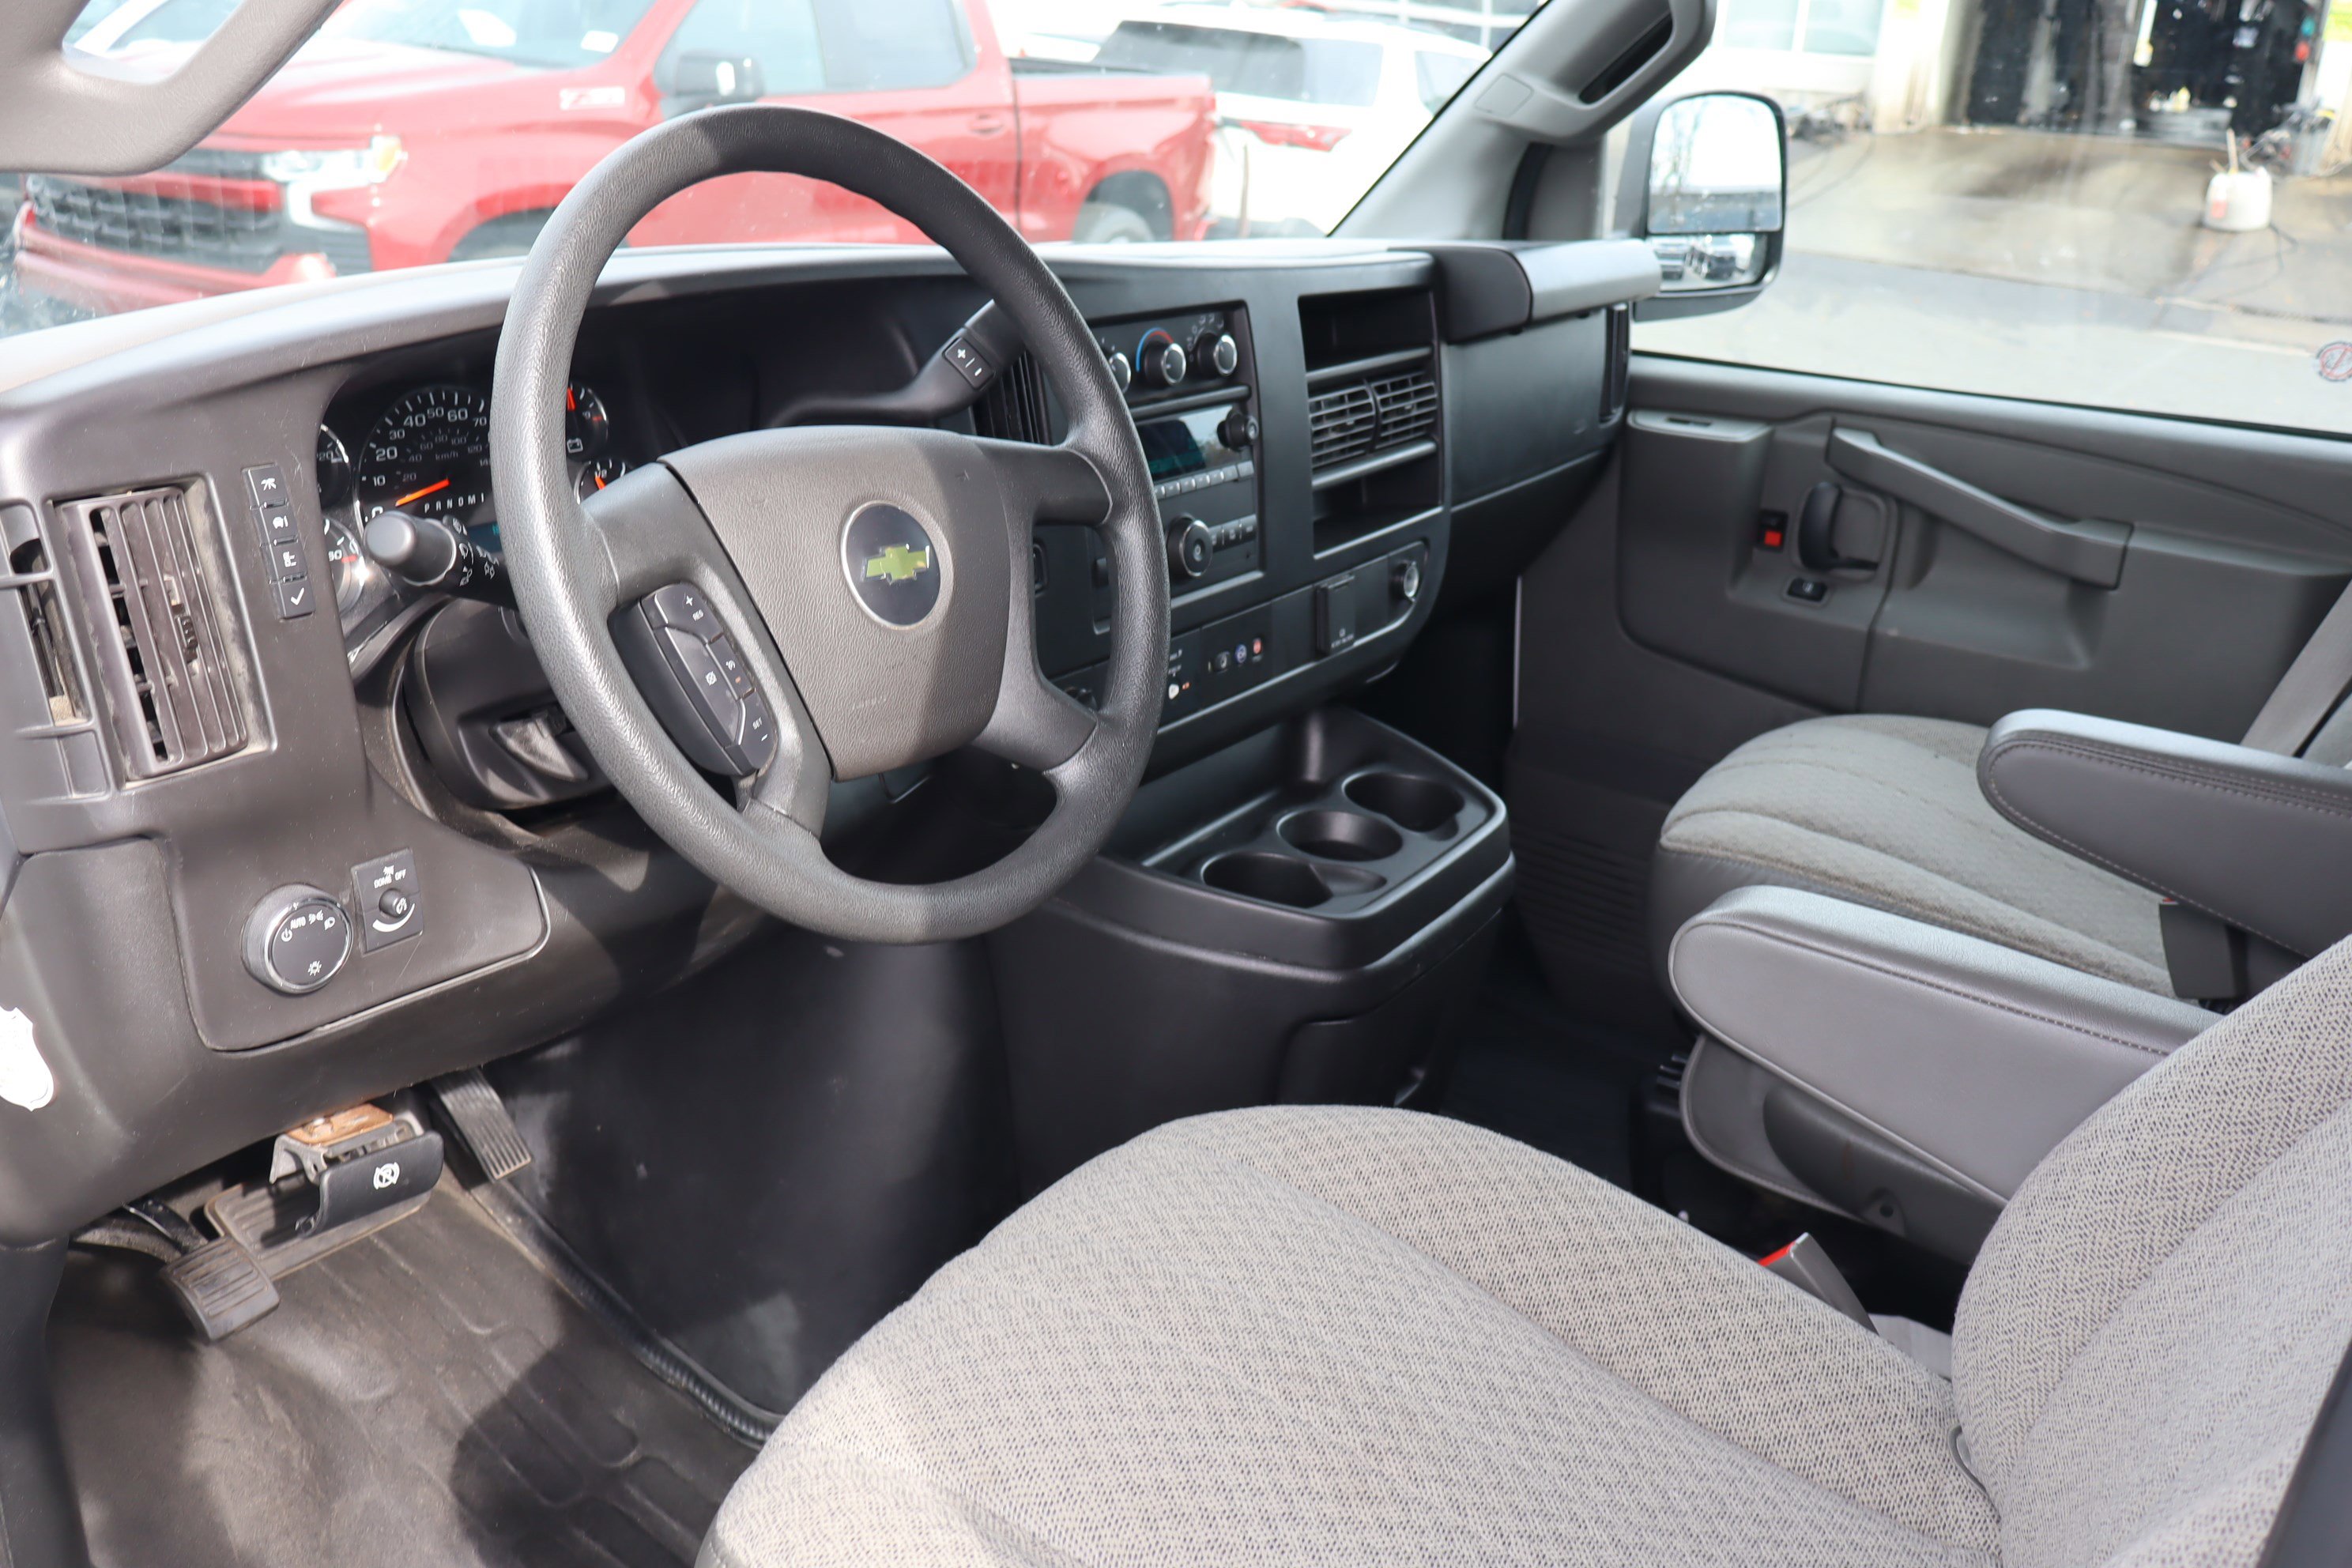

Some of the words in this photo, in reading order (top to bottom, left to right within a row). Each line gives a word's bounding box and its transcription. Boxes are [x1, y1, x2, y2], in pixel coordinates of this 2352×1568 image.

[427, 406, 444, 418] 50
[447, 408, 468, 422] 60
[403, 413, 426, 428] 40
[473, 416, 487, 428] 70
[389, 428, 405, 441] 30
[450, 436, 467, 445] 100
[375, 446, 398, 462] 20
[408, 454, 422, 463] 40
[435, 450, 459, 462] km/h
[479, 458, 491, 467] 14
[373, 475, 386, 487] 10
[394, 869, 406, 881] OFF
[290, 916, 307, 930] AUTO
